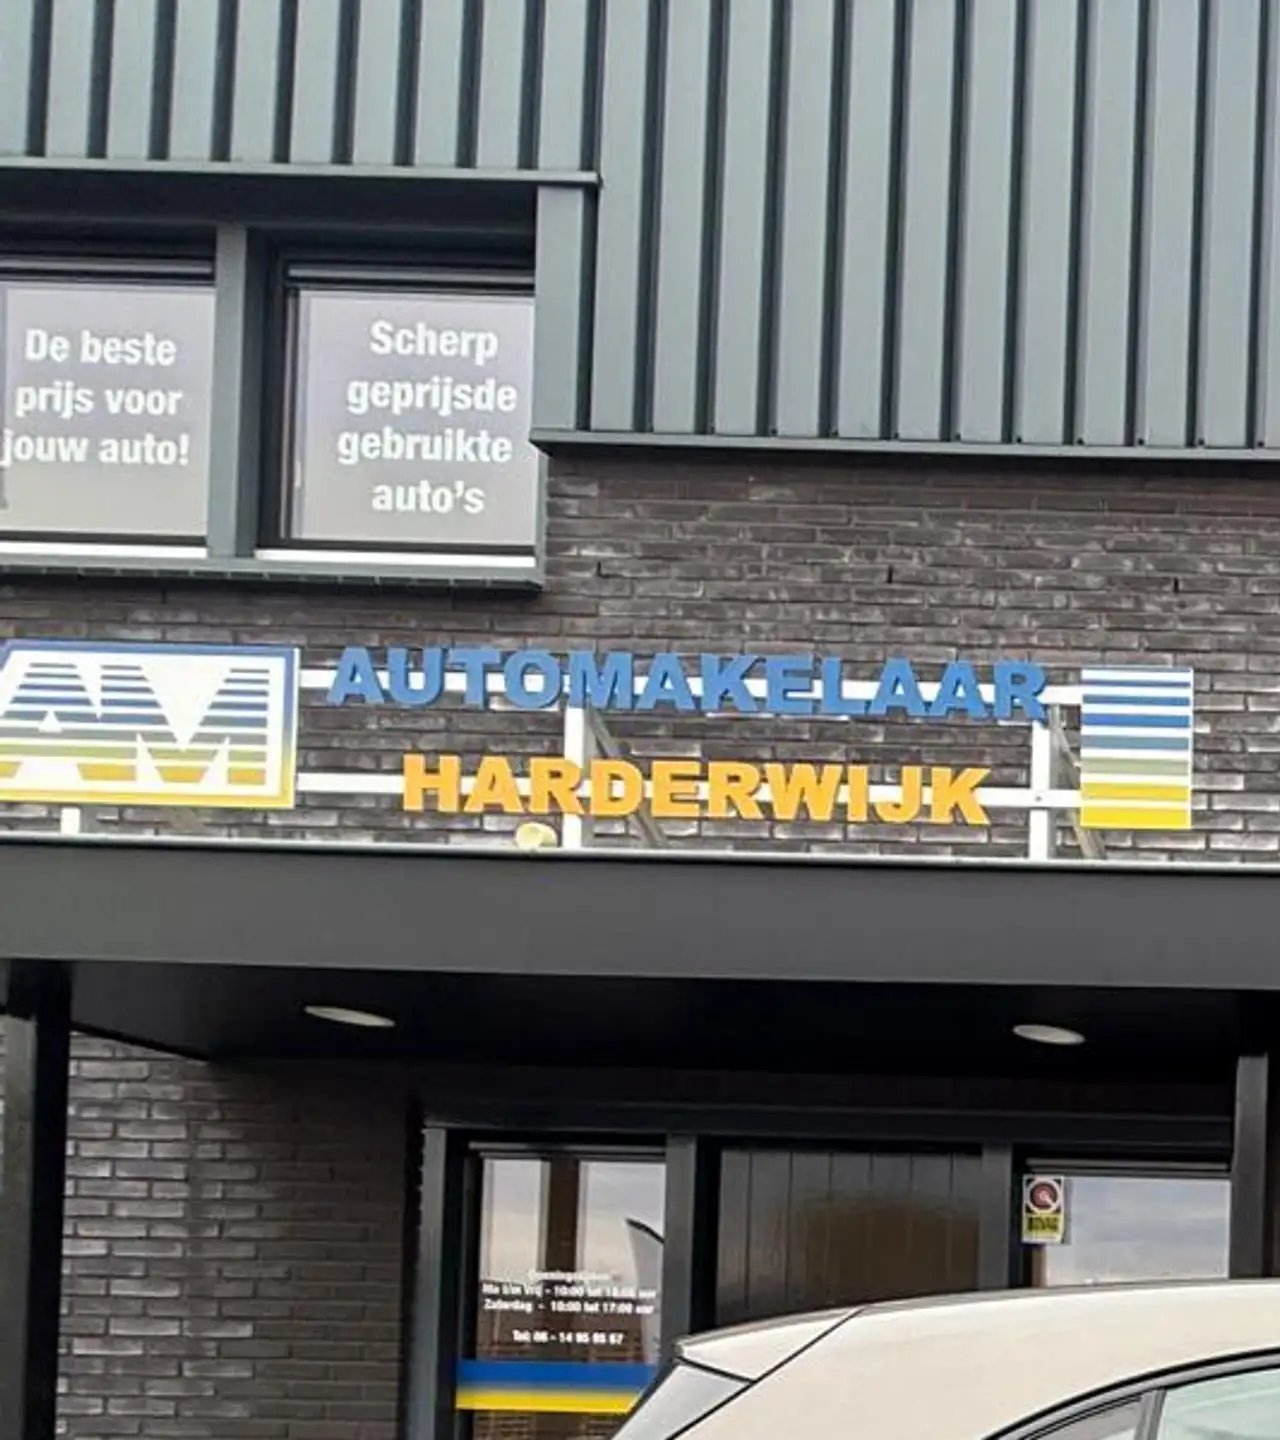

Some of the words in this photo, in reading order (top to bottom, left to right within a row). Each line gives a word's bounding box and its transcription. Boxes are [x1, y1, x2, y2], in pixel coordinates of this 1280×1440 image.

[26, 329, 69, 364] De
[81, 330, 176, 366] beste
[370, 320, 498, 366] Scherp
[15, 380, 94, 420] prijs
[105, 389, 184, 416] voor
[347, 376, 518, 417] geprijsde
[0, 428, 88, 468] jouw
[99, 433, 190, 466] auto!
[337, 425, 513, 465] gebruikte
[372, 480, 485, 514] auto's
[327, 646, 1047, 722] AUTOMAKELAAR
[403, 754, 990, 826] HARDERWIJK
